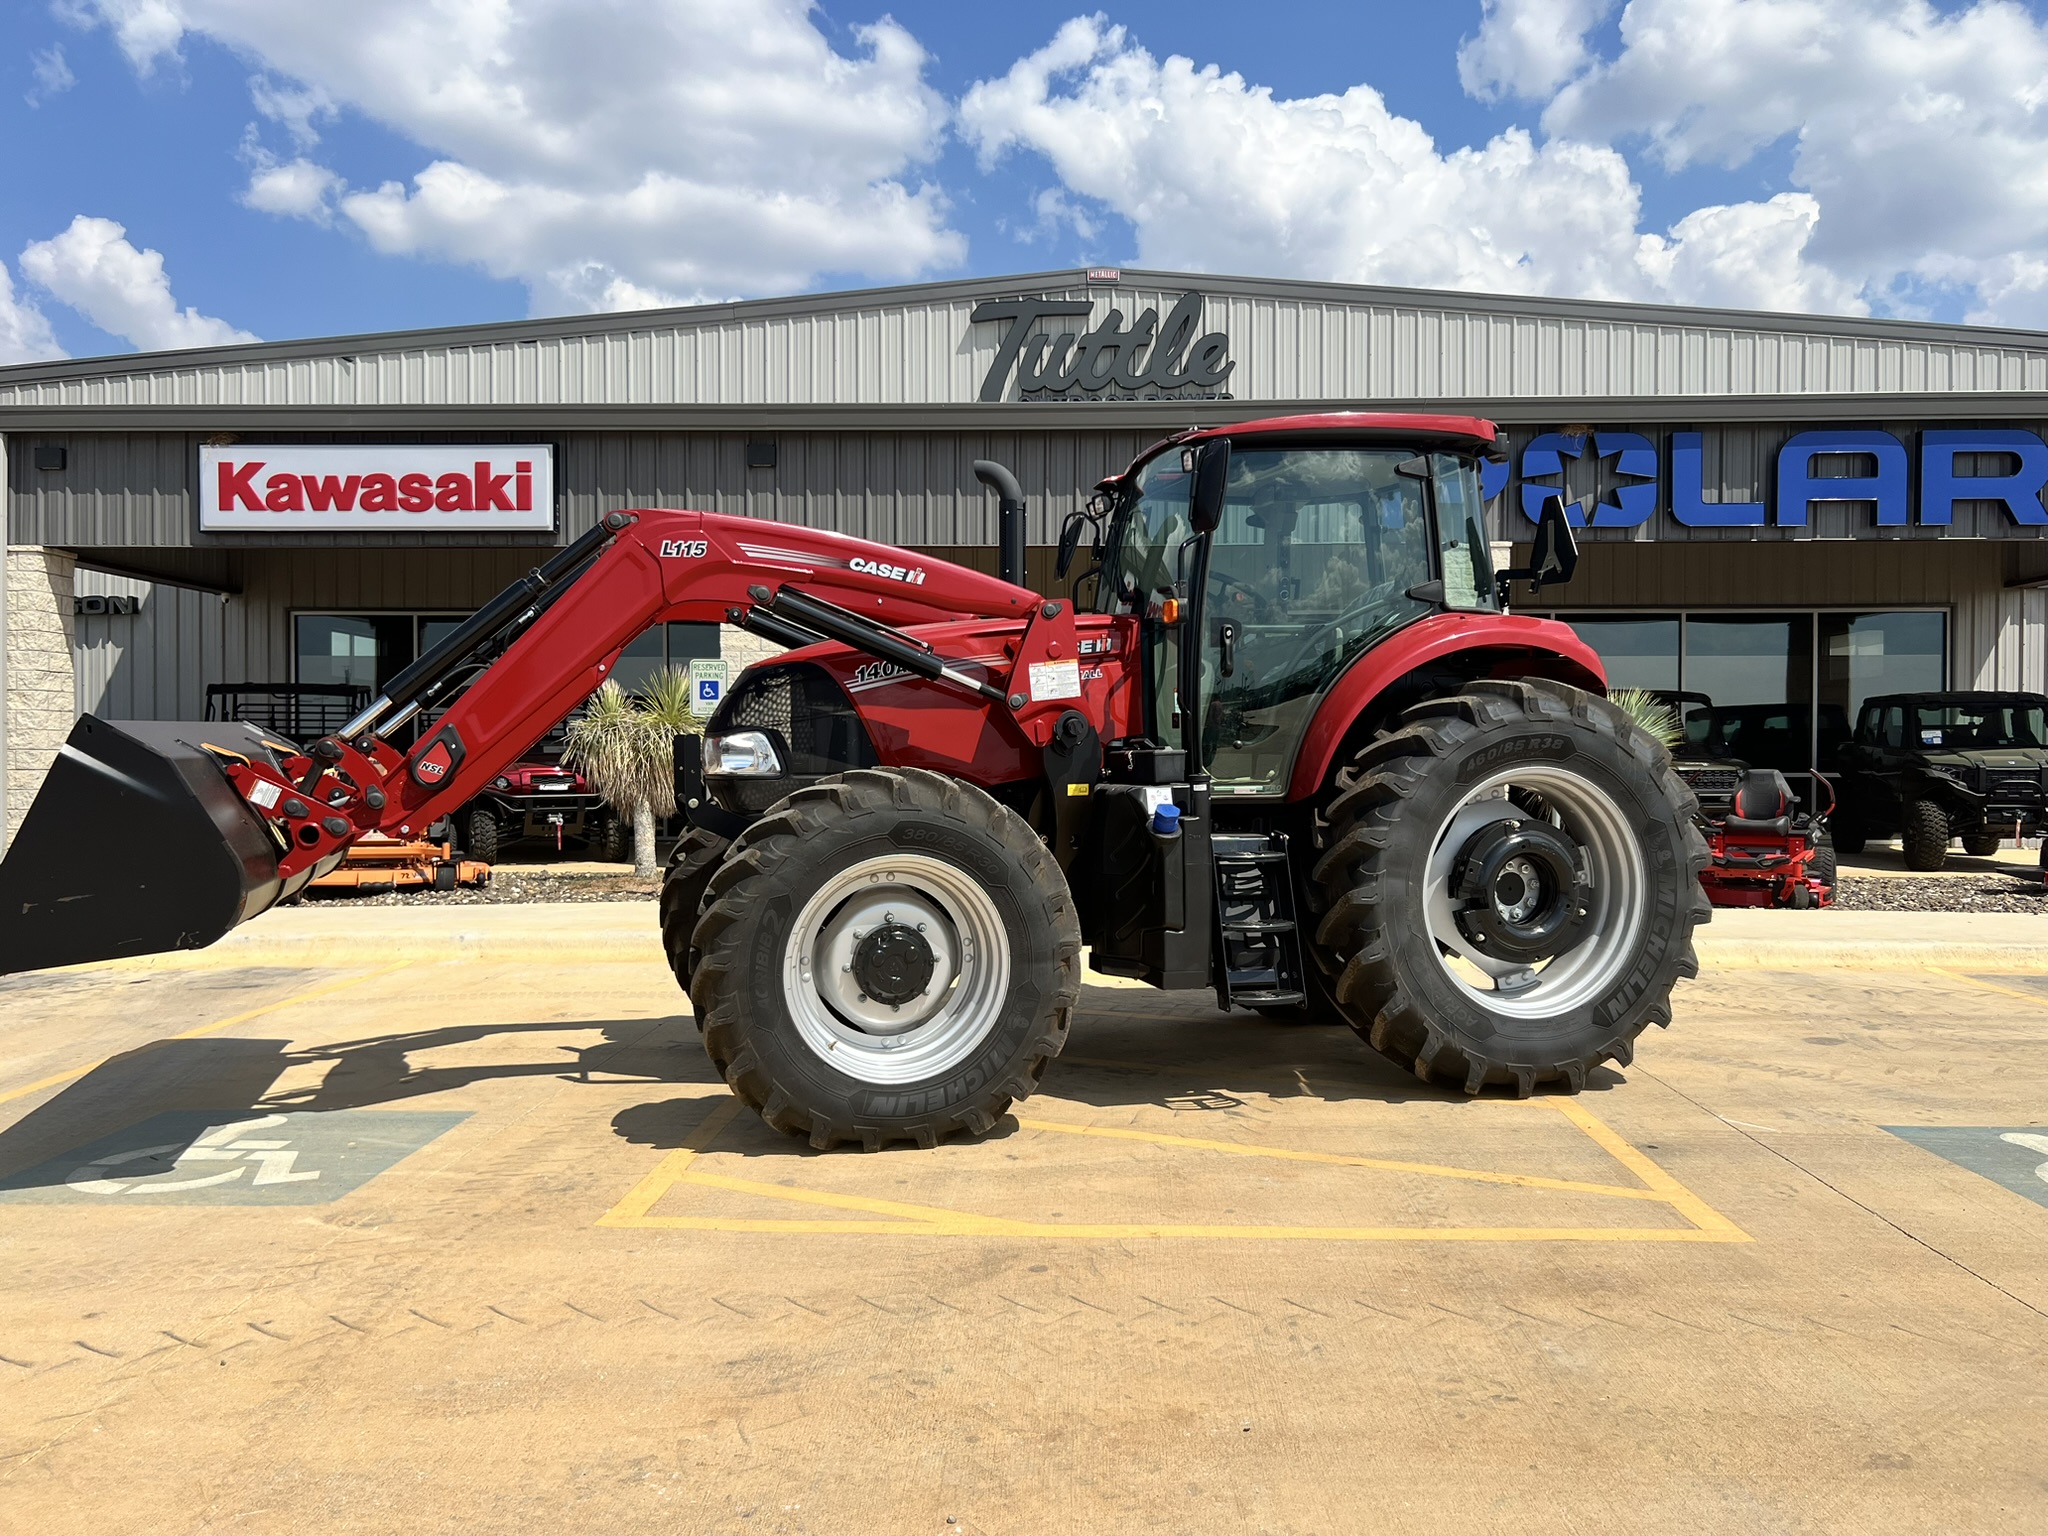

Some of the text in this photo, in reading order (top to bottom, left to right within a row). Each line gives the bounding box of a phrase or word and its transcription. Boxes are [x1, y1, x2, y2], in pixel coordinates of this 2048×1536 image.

[1090, 270, 1118, 279] METALLIC
[970, 291, 1236, 402] Tuttle
[217, 460, 533, 513] Kawasaki
[1482, 429, 2048, 528] OLAR
[659, 540, 708, 558] L115
[848, 557, 906, 581] CASE
[693, 663, 726, 671] RESERVED
[695, 672, 724, 680] PARKING
[419, 760, 444, 776] NSL
[1466, 737, 1565, 772] 460/85 R38
[902, 828, 999, 874] 380/85 R30
[1606, 872, 1676, 1022] MICHELIN
[864, 1032, 1018, 1116] MICHELIN
